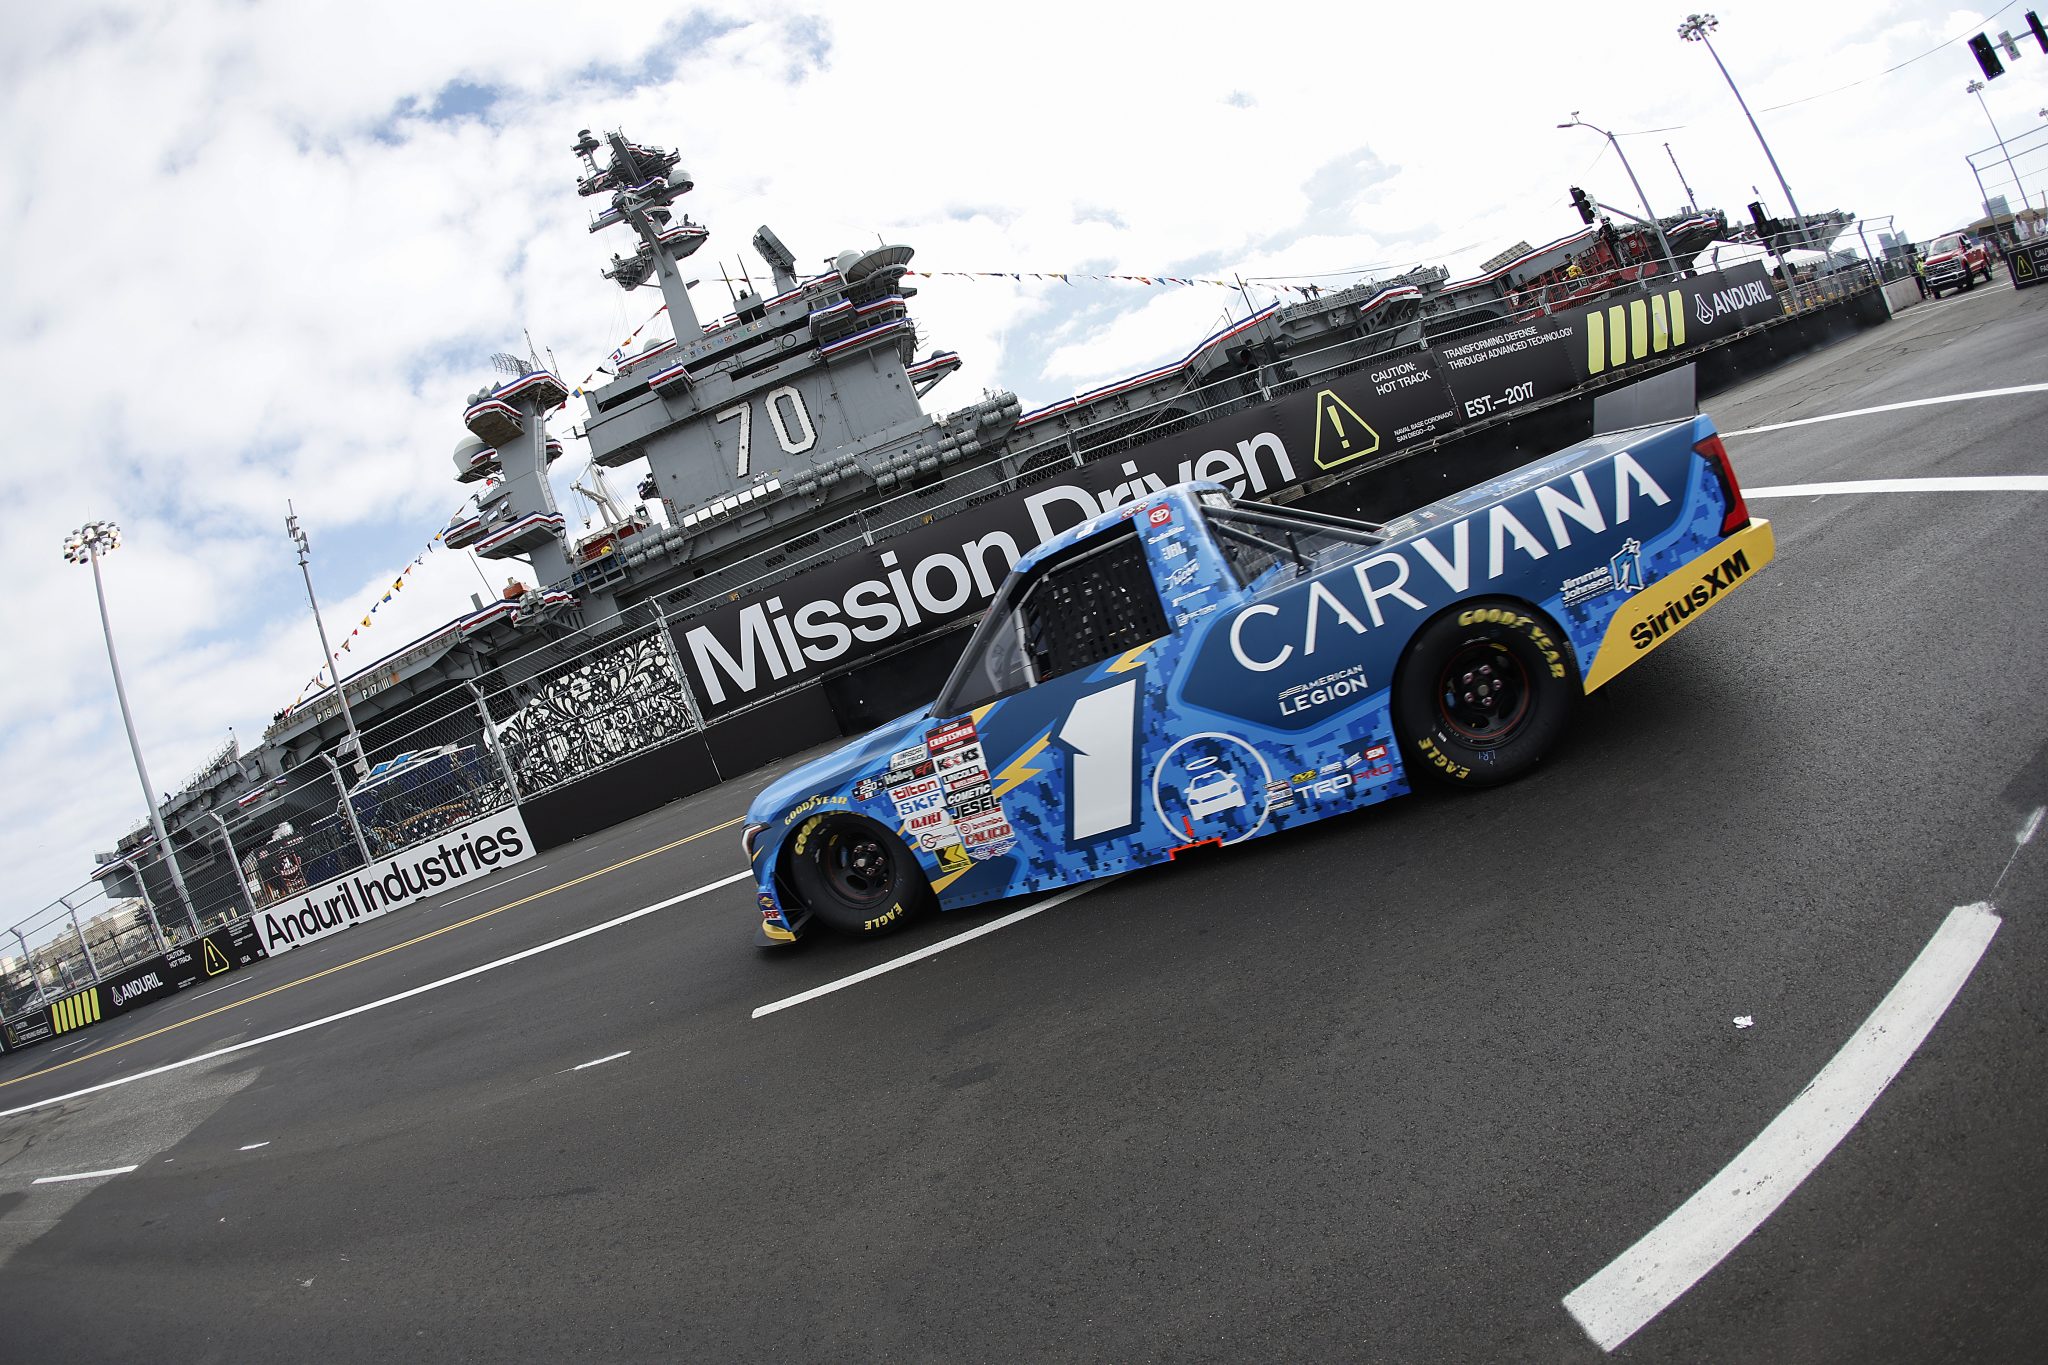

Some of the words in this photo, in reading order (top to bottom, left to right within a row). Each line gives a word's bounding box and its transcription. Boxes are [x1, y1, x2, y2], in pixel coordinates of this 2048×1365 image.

[1712, 280, 1772, 316] ANDURIL
[1443, 335, 1505, 359] TRANSFORMING
[1504, 326, 1538, 343] DEFENSE
[1448, 351, 1488, 370] THROUGH
[1488, 341, 1528, 359] ADVANCED
[1527, 327, 1573, 348] TECHNOLOGY
[1371, 361, 1416, 383] CAUTION:
[1376, 379, 1397, 396] HOT
[1398, 370, 1431, 391] TRACK
[715, 385, 818, 479] 70
[1393, 425, 1411, 436] NAVAL
[1410, 420, 1425, 431] BASE
[1424, 410, 1454, 425] CORONADO
[1396, 434, 1409, 443] SAN
[1229, 451, 1672, 672] CARVANA
[1557, 564, 1609, 591] Jimmie
[1560, 574, 1613, 600] Johnson
[1630, 548, 1751, 650] SiriusXM
[686, 529, 1021, 705] Mission
[1457, 608, 1566, 679] GOODYEAR
[1301, 664, 1364, 692] AMERICAN
[1279, 673, 1369, 717] LEGION
[1058, 678, 1137, 841] 1
[1418, 737, 1471, 779] EAGLE
[892, 778, 937, 800] tilton
[946, 783, 991, 804] COMETIC
[1294, 773, 1354, 804] TRD
[1352, 763, 1393, 783] PRO
[783, 793, 848, 826] GOODYEAR
[899, 793, 942, 815] SKF
[950, 795, 999, 820] JESEL
[963, 823, 1011, 846] CALICO
[265, 884, 361, 950] Anduril
[354, 826, 524, 914] Industries
[864, 902, 904, 931] EAGLE
[178, 954, 193, 965] TRACK
[240, 954, 252, 964] USA
[122, 971, 164, 1001] ANDURIL
